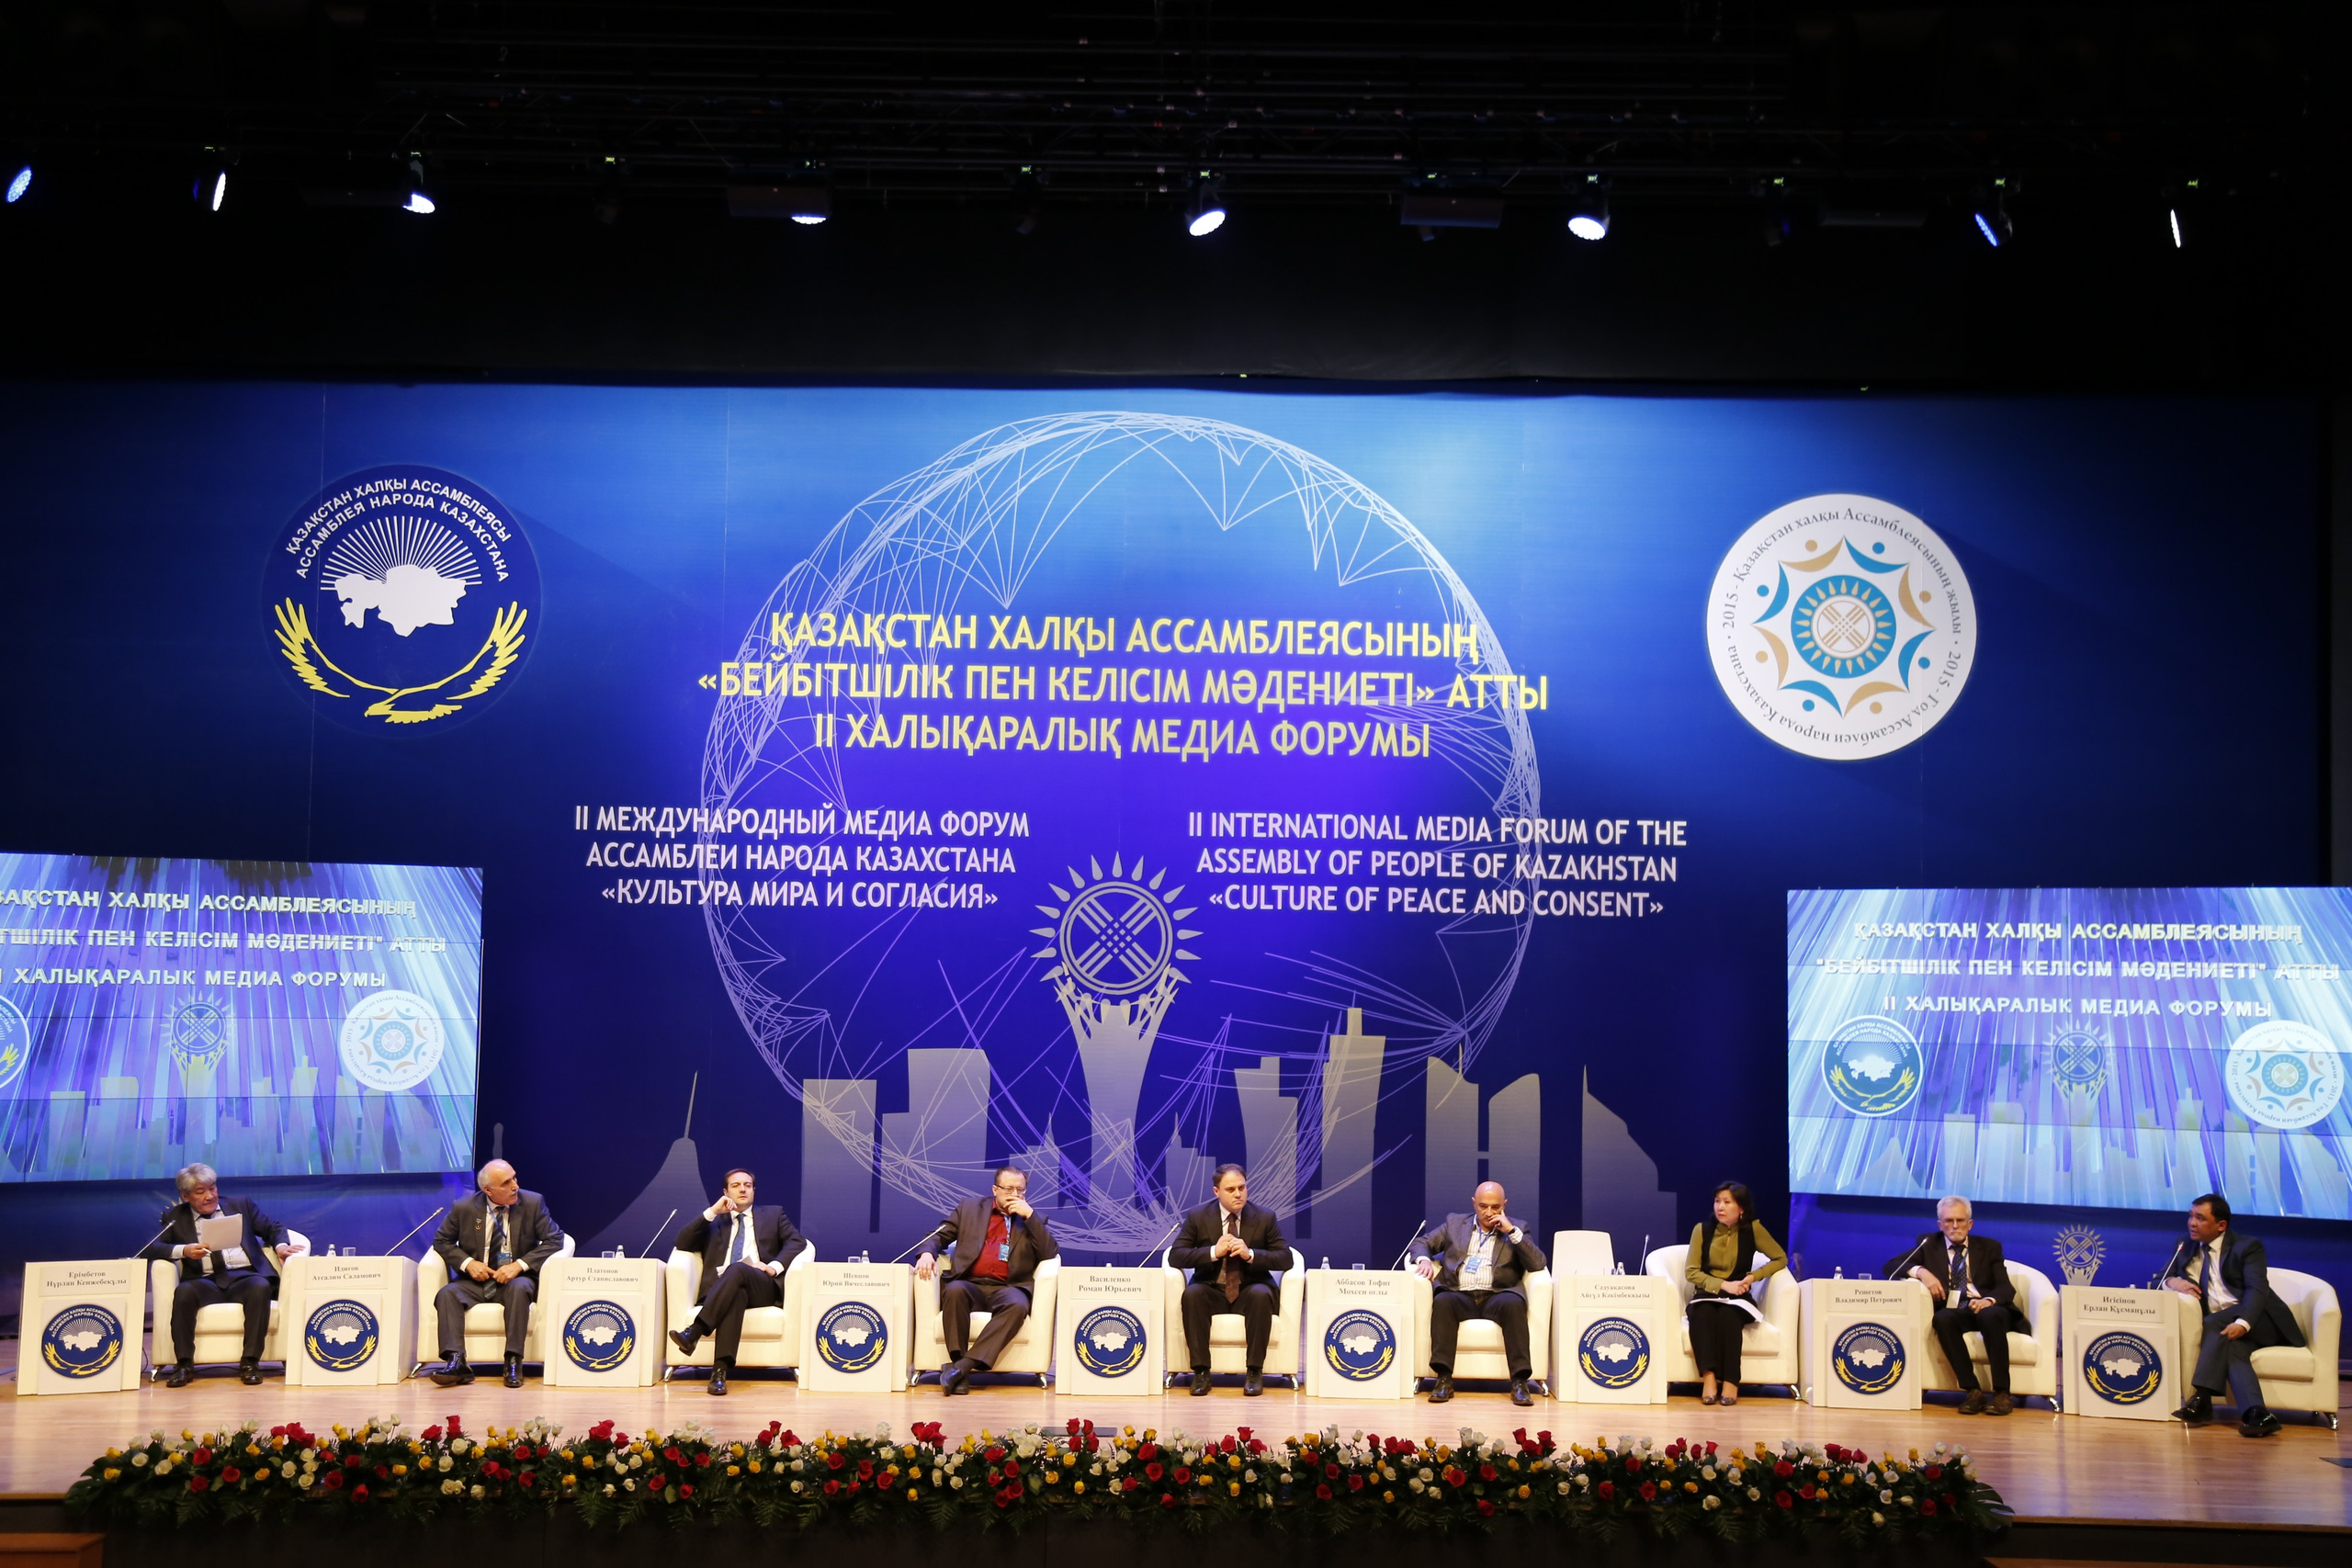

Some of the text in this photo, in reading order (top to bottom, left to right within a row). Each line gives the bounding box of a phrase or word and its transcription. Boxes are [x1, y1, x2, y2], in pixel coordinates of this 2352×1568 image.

[287, 479, 512, 554] ҚАЗАҚСТАН ХАЛҚЫ АССАМБЛЕЯСЫ
[297, 493, 509, 581] АССАМБЛЕЯ НАРОДА КАЗАХСТАНА
[1723, 508, 1962, 634] 2015 Қазақстан халқы Ассамблеясының жылы
[771, 612, 1478, 665] ҚАЗАҚСТАН ХАЛҚЫ АССАМБЛЕЯСЫНЫҢ
[698, 652, 1547, 713] «БЕЙБІТШІЛІК ПЕН КЕЛІСІМ МӘДЕНИЕТІ» АТТЫ
[1727, 645, 1961, 746] 2015 Год Ассамблеи народа Казахстана
[845, 714, 1121, 759] ХАЛЫҚАРАЛЫҚ
[1131, 718, 1260, 762] МЕДИА
[1272, 720, 1430, 757] ФОРУМЫ
[575, 802, 1030, 840] II МЕЖДУНАРОДНЫЙ МЕДИА ФОРУМ
[1189, 812, 1687, 846] II INTERNATIONAL MEDIA FORUM OF THE
[585, 842, 1016, 876] АССАМБЛЕИ НАРОДА КАЗАХСТАНА
[1197, 848, 1677, 882] ASSEMBLY OF PEOPLE OF KAZAKHSTAN
[108, 892, 189, 911] ХАЛҚЫ
[199, 895, 416, 919] АССАМБЛЕЯСЫНЫҢ
[602, 879, 998, 908] «КУЛЬТУРА МИРА И СОГЛАСИЯ»
[1209, 884, 1664, 918] «CULTURE OF PEACE AND CONSENT»
[88, 930, 135, 946] ПЕН
[146, 931, 238, 949] КЕЛІСІМ
[390, 936, 446, 953] АТТЫ
[1854, 923, 2302, 943] ҚАЗАҚСТАН ХАЛҚЫ АССАМБЛЕЯСЫНЫҢ
[206, 970, 283, 987] МЕДИА
[291, 972, 386, 987] ФОРУМЫ
[1969, 960, 2012, 976] ПЕН
[2022, 961, 2111, 977] КЕЛІСІМ
[2274, 964, 2339, 981] АТТЫ
[1884, 996, 1895, 1010] II
[2081, 998, 2160, 1017] МЕДИА
[2169, 1000, 2271, 1017] ФОРУМЫ
[1104, 1285, 1141, 1293] Юрьевич
